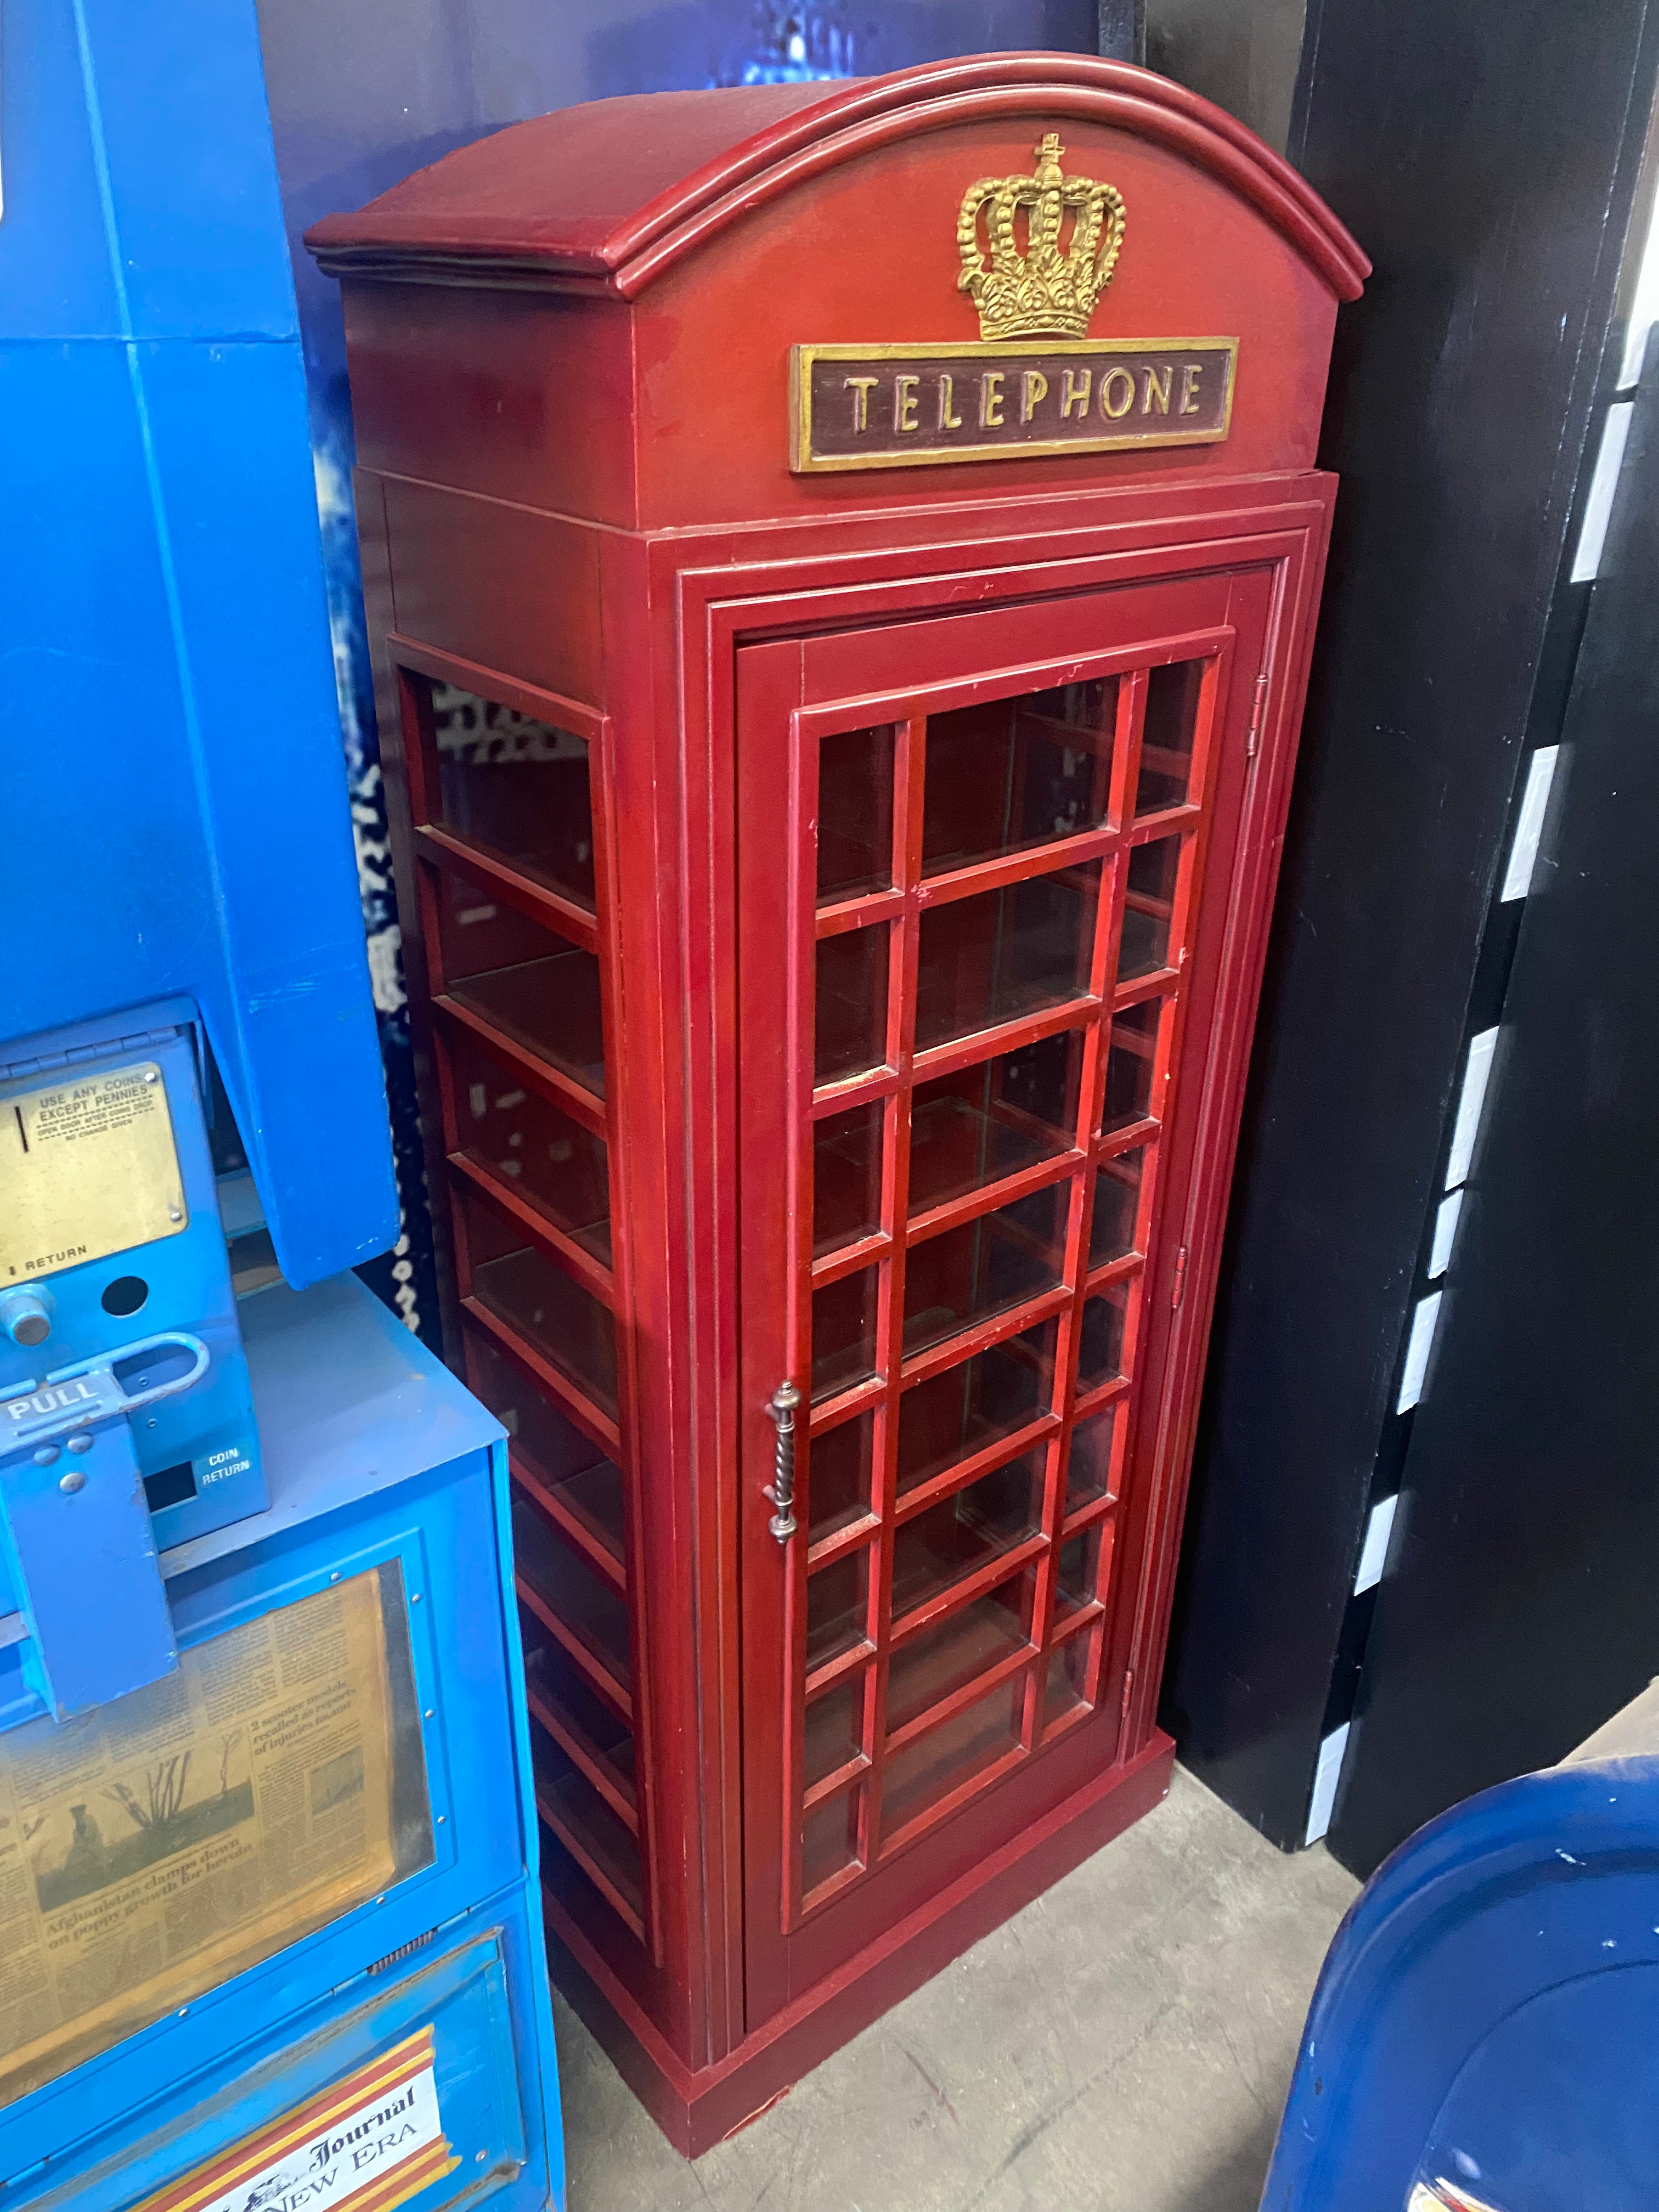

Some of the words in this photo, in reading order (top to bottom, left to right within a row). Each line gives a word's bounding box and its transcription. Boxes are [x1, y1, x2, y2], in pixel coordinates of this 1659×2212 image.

[844, 364, 1203, 435] TELEPHONE
[40, 1093, 66, 1108] USE
[73, 1085, 98, 1100] ANY
[104, 1074, 144, 1091] COINS
[40, 1099, 88, 1122] EXCEPT
[95, 1084, 148, 1107] PENNIES
[25, 1244, 88, 1272] RETURN
[7, 1383, 100, 1420] PULL
[202, 1459, 251, 1486] RETURN
[208, 1448, 239, 1466] COIN
[251, 1720, 261, 1733] 2
[261, 1701, 305, 1727] scooter
[306, 1680, 347, 1705] models
[253, 1713, 299, 1745] recalled
[301, 1707, 314, 1720] as
[315, 1688, 357, 1713] reports
[254, 1738, 269, 1756] of
[269, 1720, 314, 1750] injuries
[315, 1700, 352, 1725] mount
[46, 1886, 142, 1938] Afghanistan
[144, 1859, 198, 1891] clamps
[199, 1837, 240, 1864] down
[48, 1933, 71, 1950] on
[72, 1909, 120, 1942] poppy
[123, 1882, 179, 1917] growth
[180, 1867, 203, 1886] for
[205, 1843, 253, 1874] heroin
[308, 2085, 416, 2174] Journal
[261, 2167, 340, 2212] NEW
[351, 2122, 419, 2172] ERA
